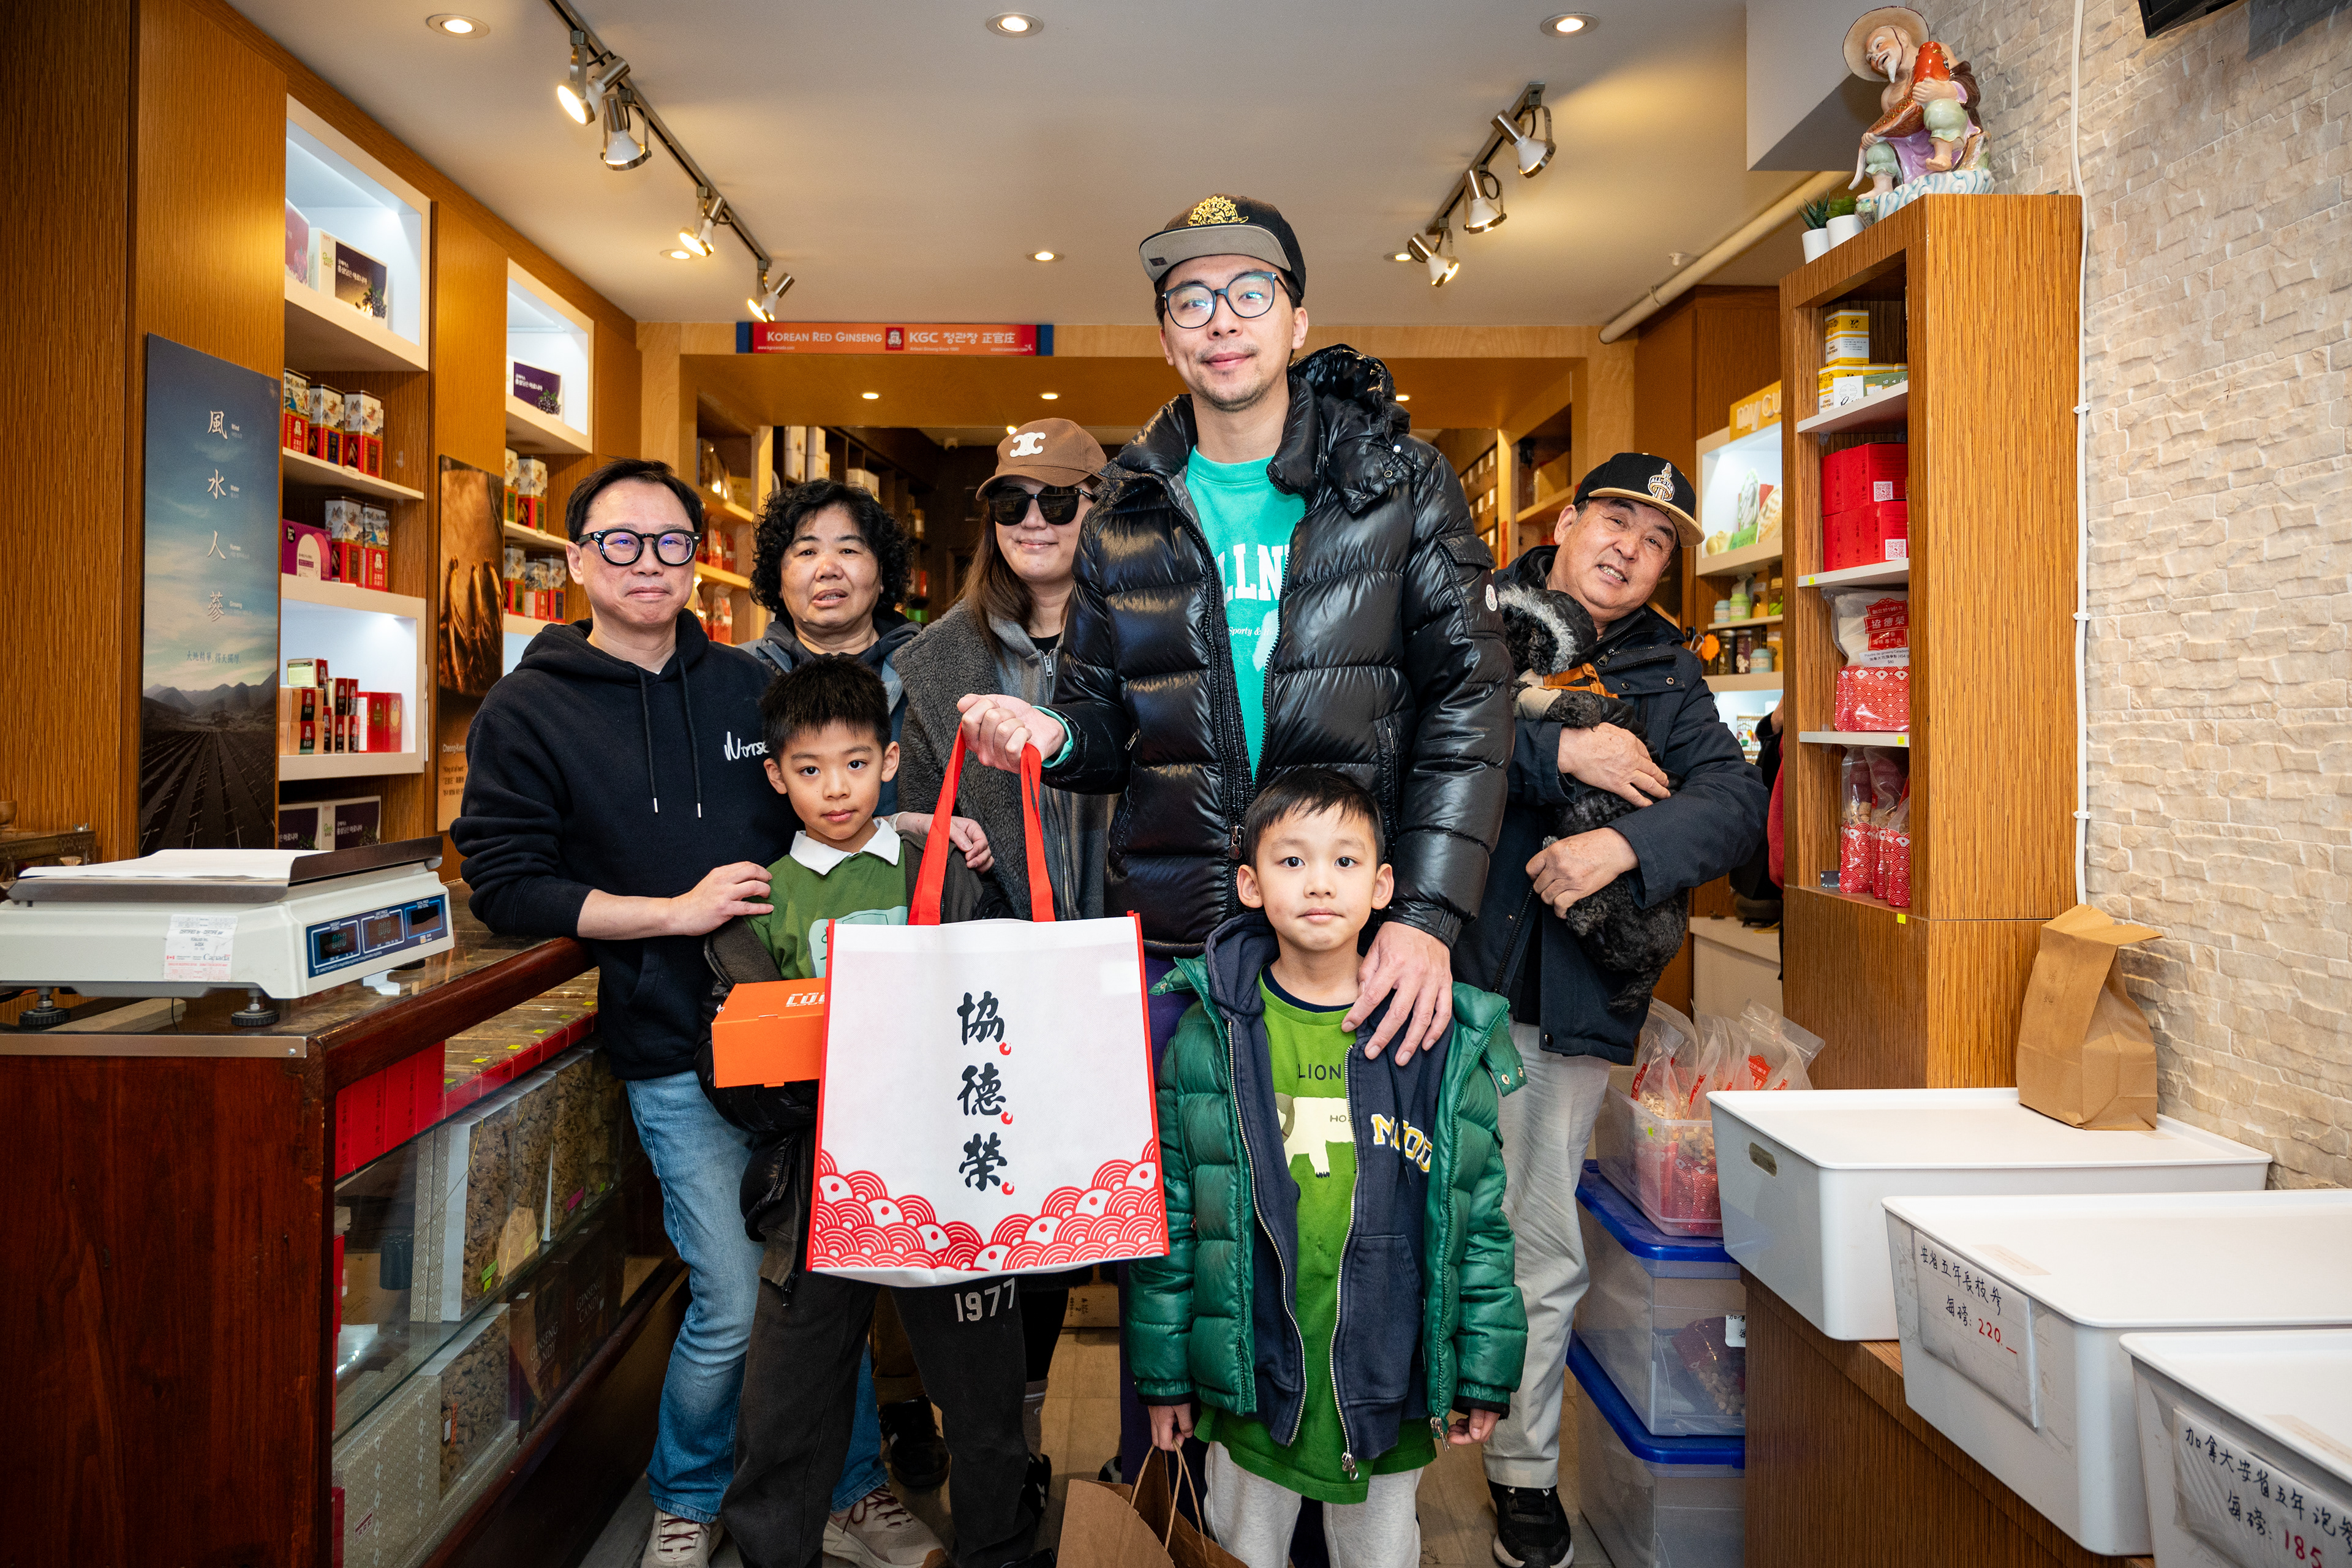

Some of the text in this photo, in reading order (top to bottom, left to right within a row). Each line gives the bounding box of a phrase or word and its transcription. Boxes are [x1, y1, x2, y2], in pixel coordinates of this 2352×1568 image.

[767, 331, 883, 342] KOREAN RED GINSENG
[909, 332, 1016, 344] KGC 정관장 正官庄
[208, 410, 228, 440] 風
[1736, 400, 1762, 431] my
[207, 469, 227, 500] 水
[207, 530, 227, 560] 人
[1218, 543, 1290, 607] LLN
[1229, 627, 1253, 636] Sporty
[1871, 616, 1905, 629] 協德榮
[1298, 1063, 1341, 1080] LION
[957, 990, 1008, 1192] 協德榮
[576, 1276, 601, 1311] GINSENG
[579, 1294, 599, 1323] CANDY
[954, 1277, 1016, 1322] 1977
[530, 1321, 559, 1361] GINSENG
[533, 1339, 556, 1374] CANDY
[2285, 1529, 2323, 1568] 185
